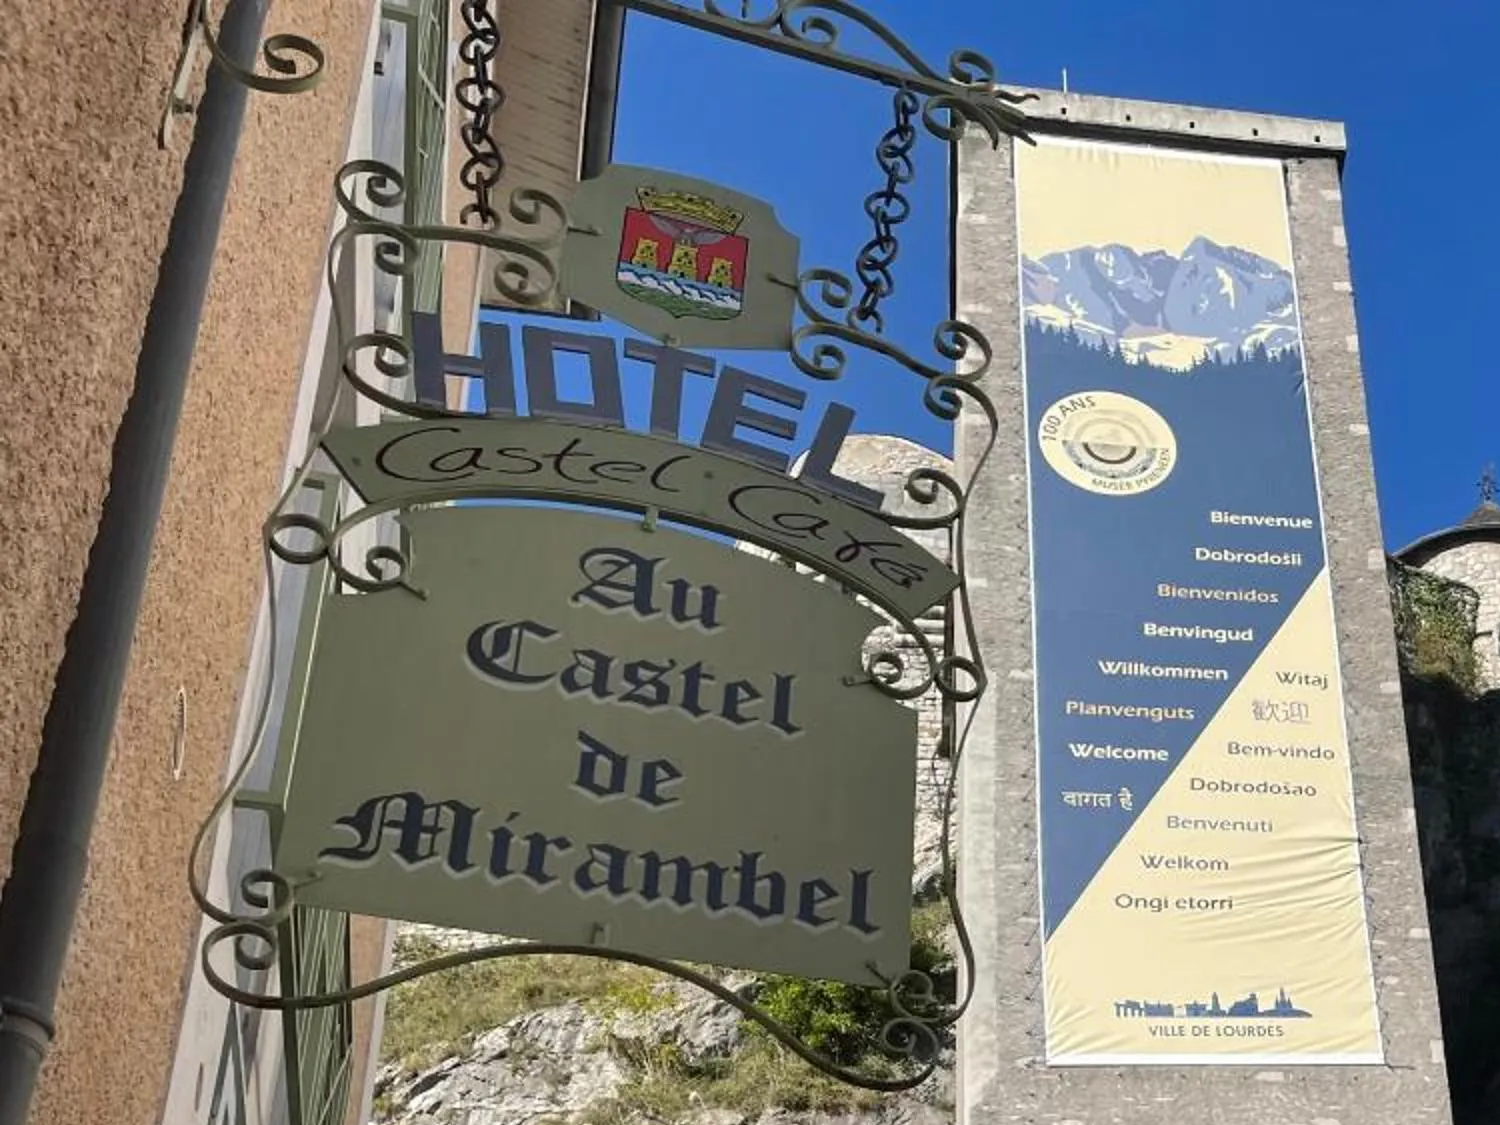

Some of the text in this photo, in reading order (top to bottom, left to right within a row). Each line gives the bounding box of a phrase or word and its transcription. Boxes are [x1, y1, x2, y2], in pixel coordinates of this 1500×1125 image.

[413, 311, 885, 511] HOTEL
[1042, 395, 1096, 441] 100 ANS
[375, 426, 928, 588] Castel Café
[1210, 511, 1313, 529] Bienvenue
[571, 547, 721, 630] Au
[1157, 583, 1279, 603] Bienvenidos
[1143, 622, 1253, 643] Benvingud
[465, 620, 801, 734] Castel
[1098, 660, 1228, 680] Willkommen
[1276, 671, 1328, 690] Witaj
[1066, 701, 1195, 722] Planvenguts
[1068, 743, 1169, 761] Welcome
[1227, 741, 1336, 760] Bem-vindo
[575, 727, 684, 808] de
[1167, 815, 1273, 833] Benvenuti
[319, 792, 880, 935] Mirambel
[1140, 855, 1229, 871] Welkom
[1115, 893, 1234, 912] Ongi etorri
[1149, 1025, 1285, 1037] VILLE DE LOURDES
